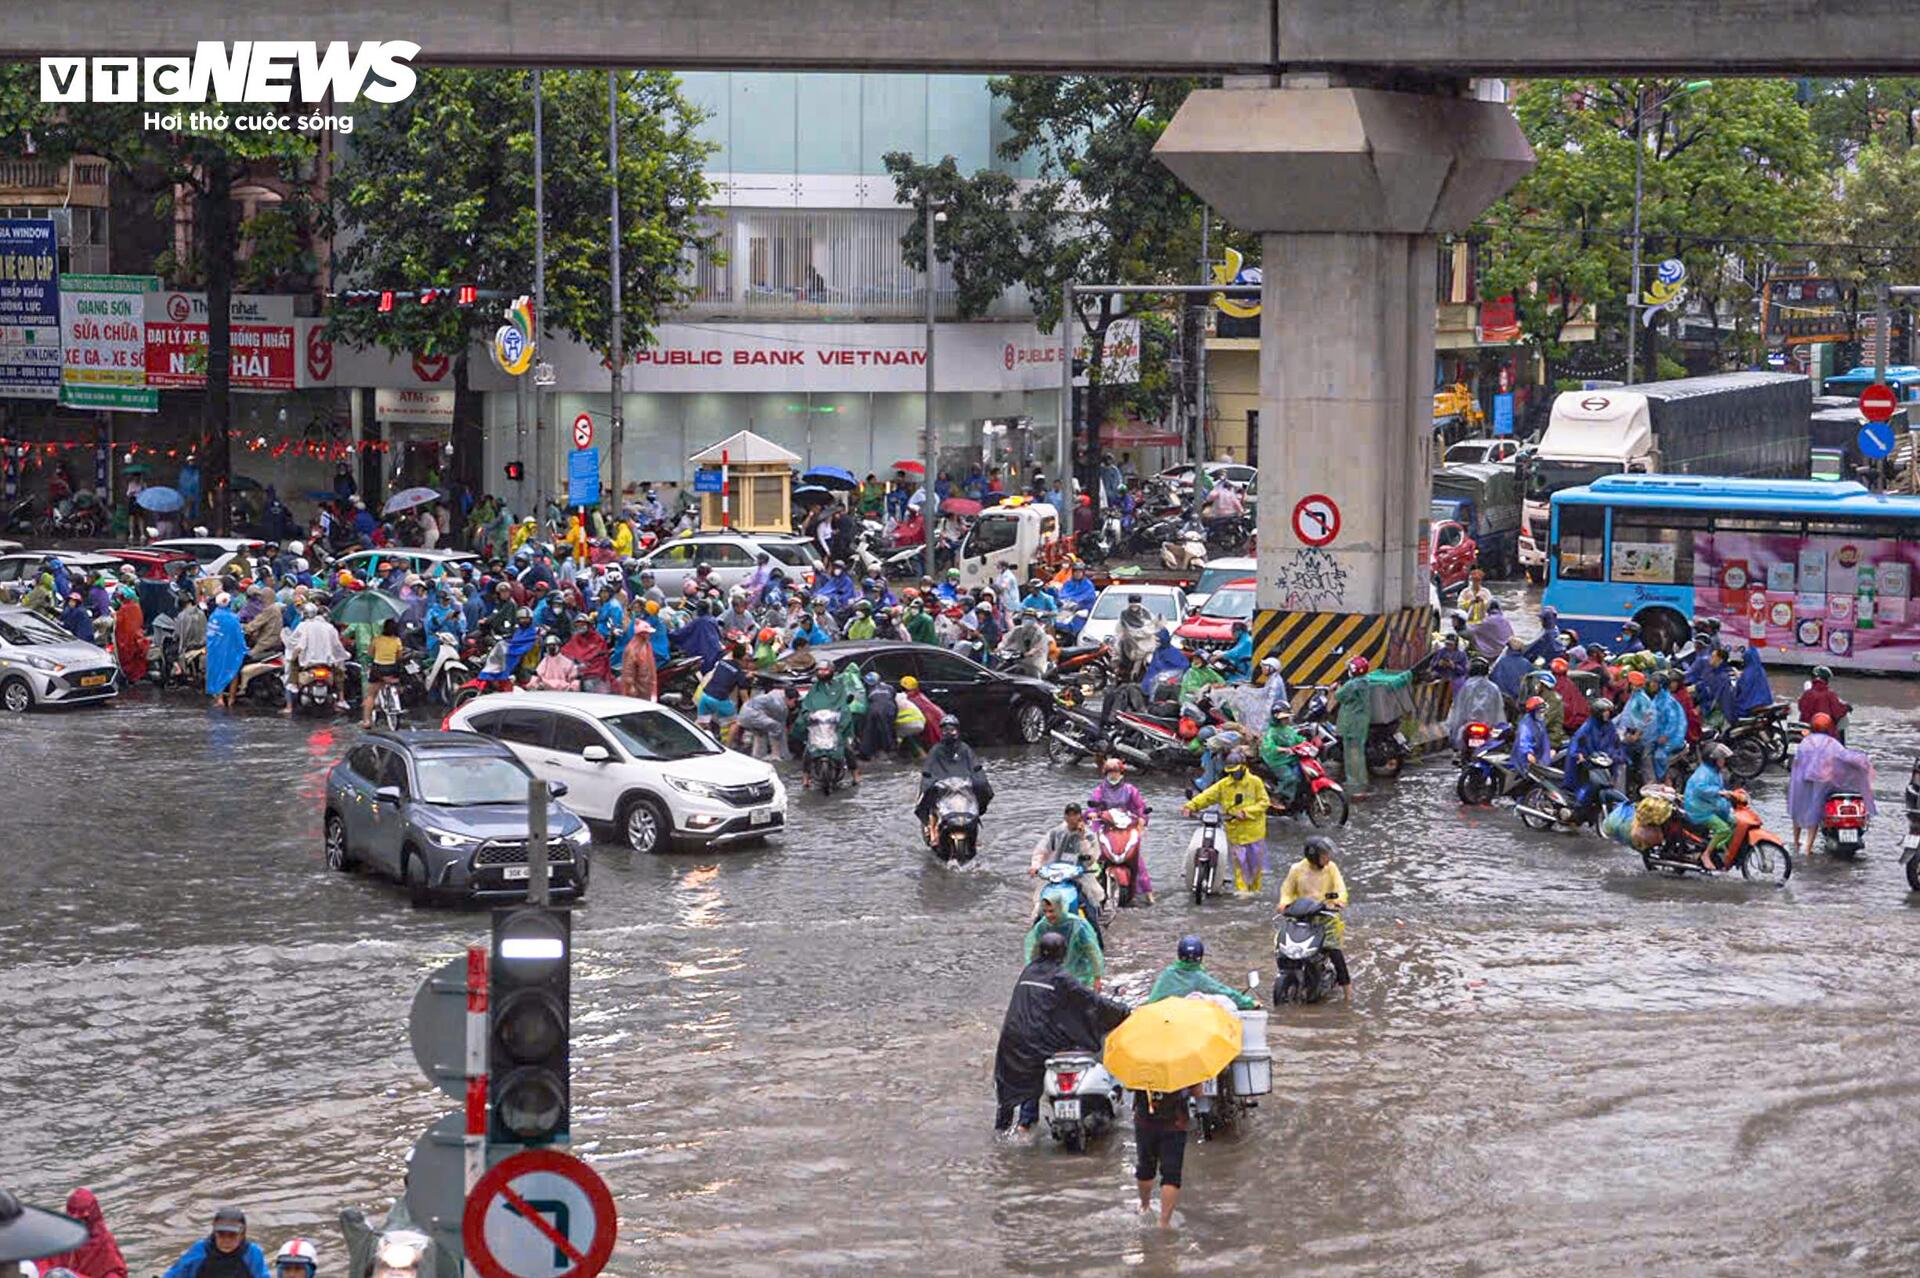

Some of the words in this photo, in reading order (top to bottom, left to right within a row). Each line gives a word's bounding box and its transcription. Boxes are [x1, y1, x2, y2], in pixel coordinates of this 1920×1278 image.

[11, 227, 50, 239] WINDOW
[77, 300, 109, 315] GIANG
[73, 318, 99, 341] SỬA
[147, 329, 166, 348] ĐẠI
[168, 326, 182, 345] LÝ
[229, 329, 260, 348] HỐNG
[262, 328, 291, 349] NHẤT
[65, 349, 80, 365] XE
[84, 350, 100, 366] GA
[112, 350, 127, 367] XE
[232, 350, 270, 377] HẢI
[635, 350, 723, 365] PUBLIC
[733, 350, 805, 365] BANK
[816, 350, 928, 366] VIETNAM
[1017, 348, 1055, 364] PUBLIC
[399, 391, 424, 403] ATM
